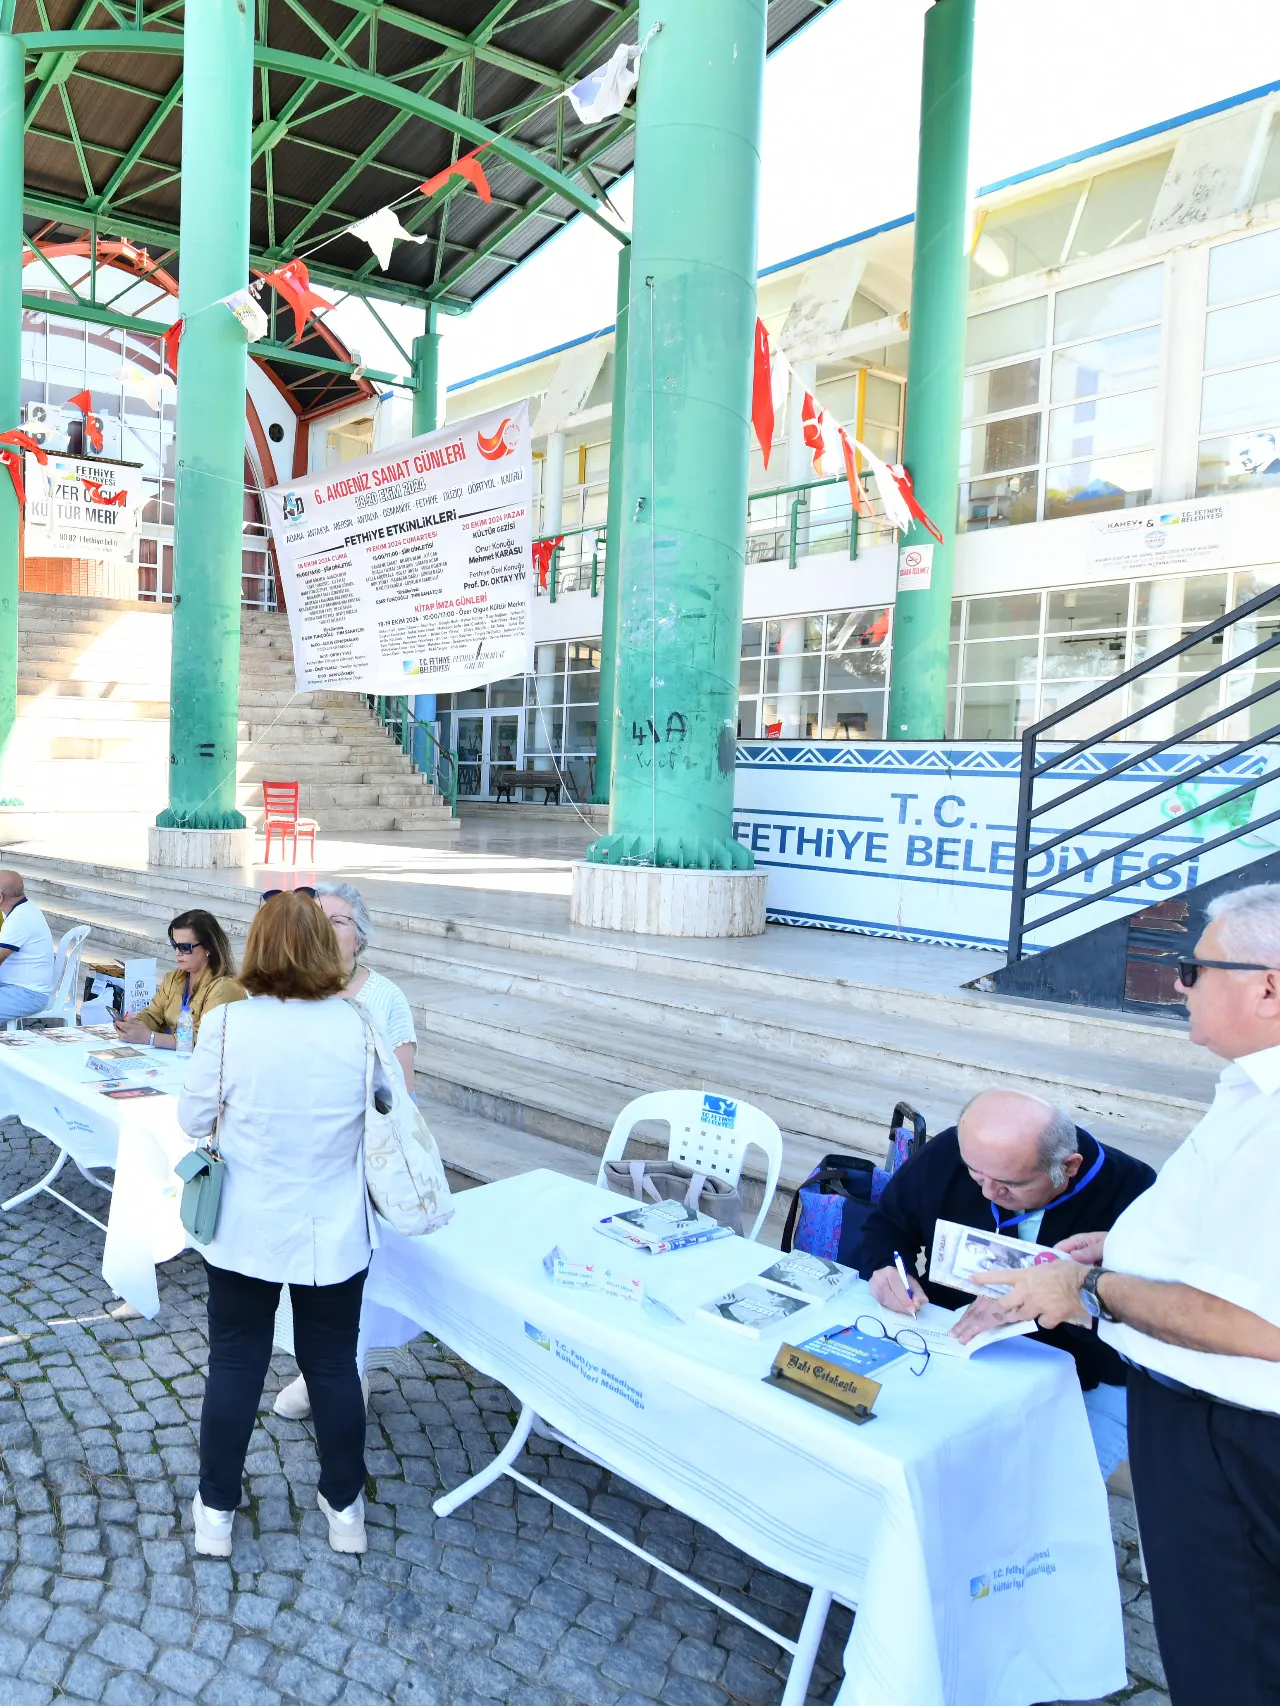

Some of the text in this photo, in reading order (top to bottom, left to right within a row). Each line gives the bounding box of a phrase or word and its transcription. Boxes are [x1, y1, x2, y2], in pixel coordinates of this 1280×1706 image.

[314, 437, 467, 505] 6. AKDENİZ SANAT GÜNLERİ
[31, 499, 81, 520] KÜTÜR
[503, 509, 525, 521] PAZAR
[472, 527, 496, 539] KÜLTÜR
[1107, 520, 1138, 529] KAHEV
[1146, 519, 1155, 528] &
[468, 546, 523, 565] Mehmet KARASU
[463, 581, 480, 590] Prof.
[480, 579, 490, 587] Dr.
[490, 574, 513, 586] OKTAY
[414, 592, 488, 613] KİTAP İMZA GÜNLERİ
[890, 791, 979, 829] T.C.
[555, 1339, 643, 1399] T.C. Fethiye Belediyesi
[1005, 1565, 1025, 1577] Fethi
